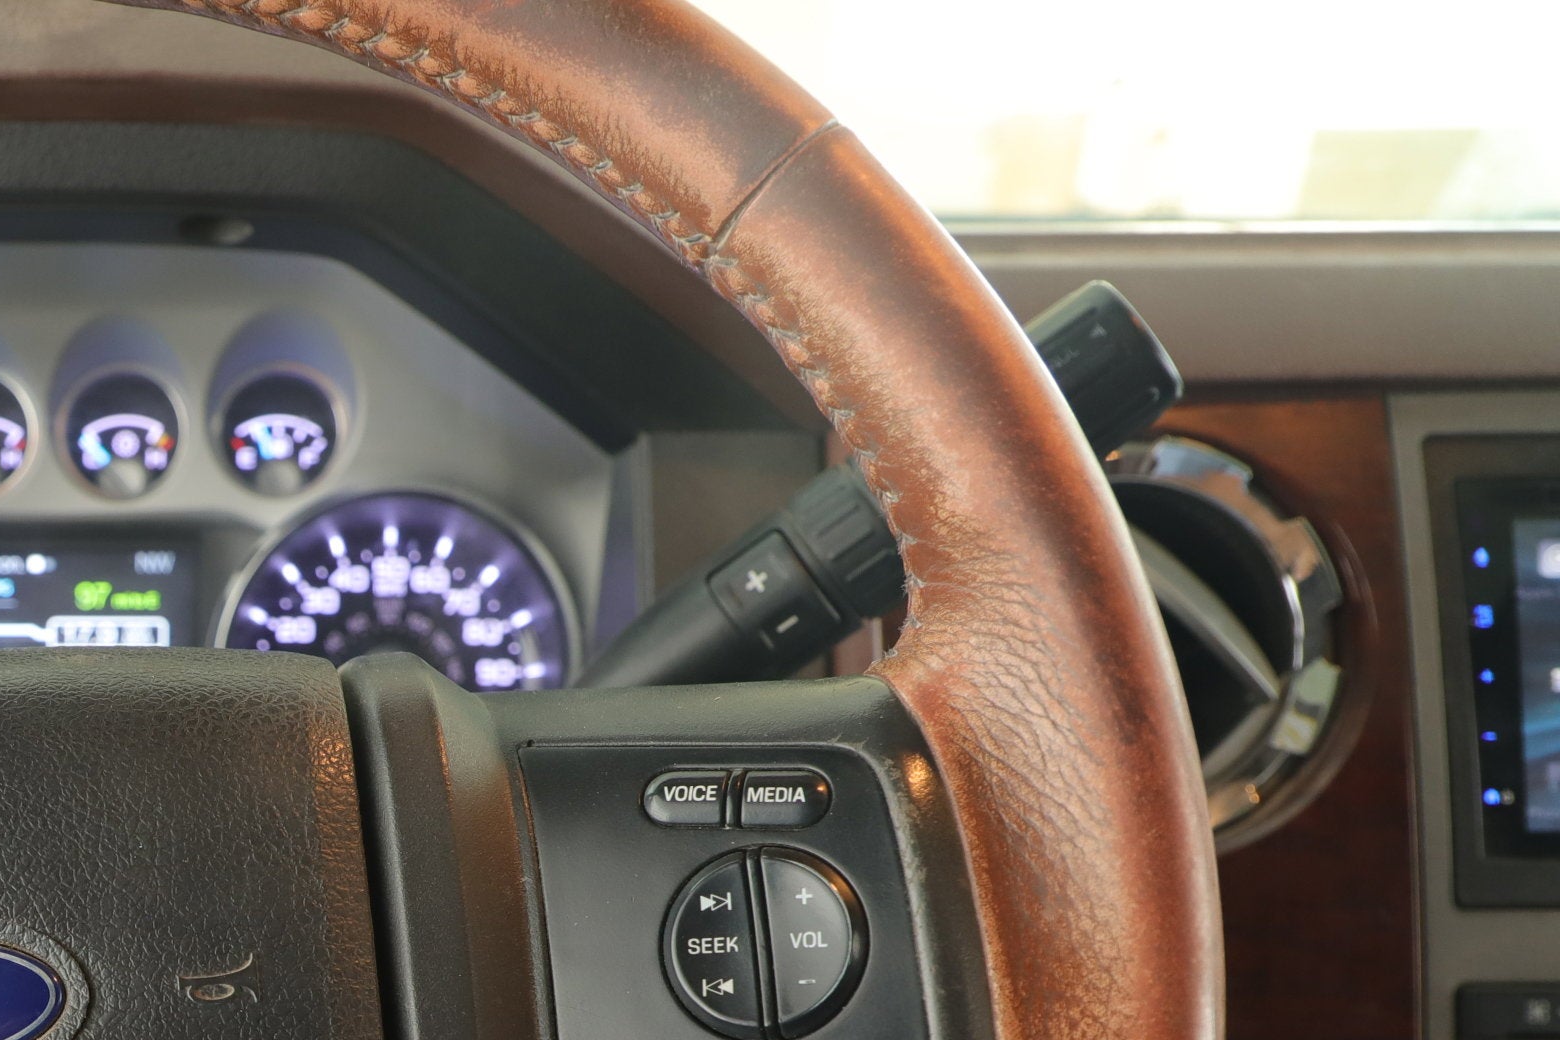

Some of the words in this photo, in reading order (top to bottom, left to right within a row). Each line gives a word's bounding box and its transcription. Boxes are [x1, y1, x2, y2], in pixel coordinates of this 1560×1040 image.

[663, 784, 718, 802] VOICE
[746, 786, 806, 803] MEDIA
[687, 936, 739, 955] SEEK
[790, 931, 828, 949] VOL
